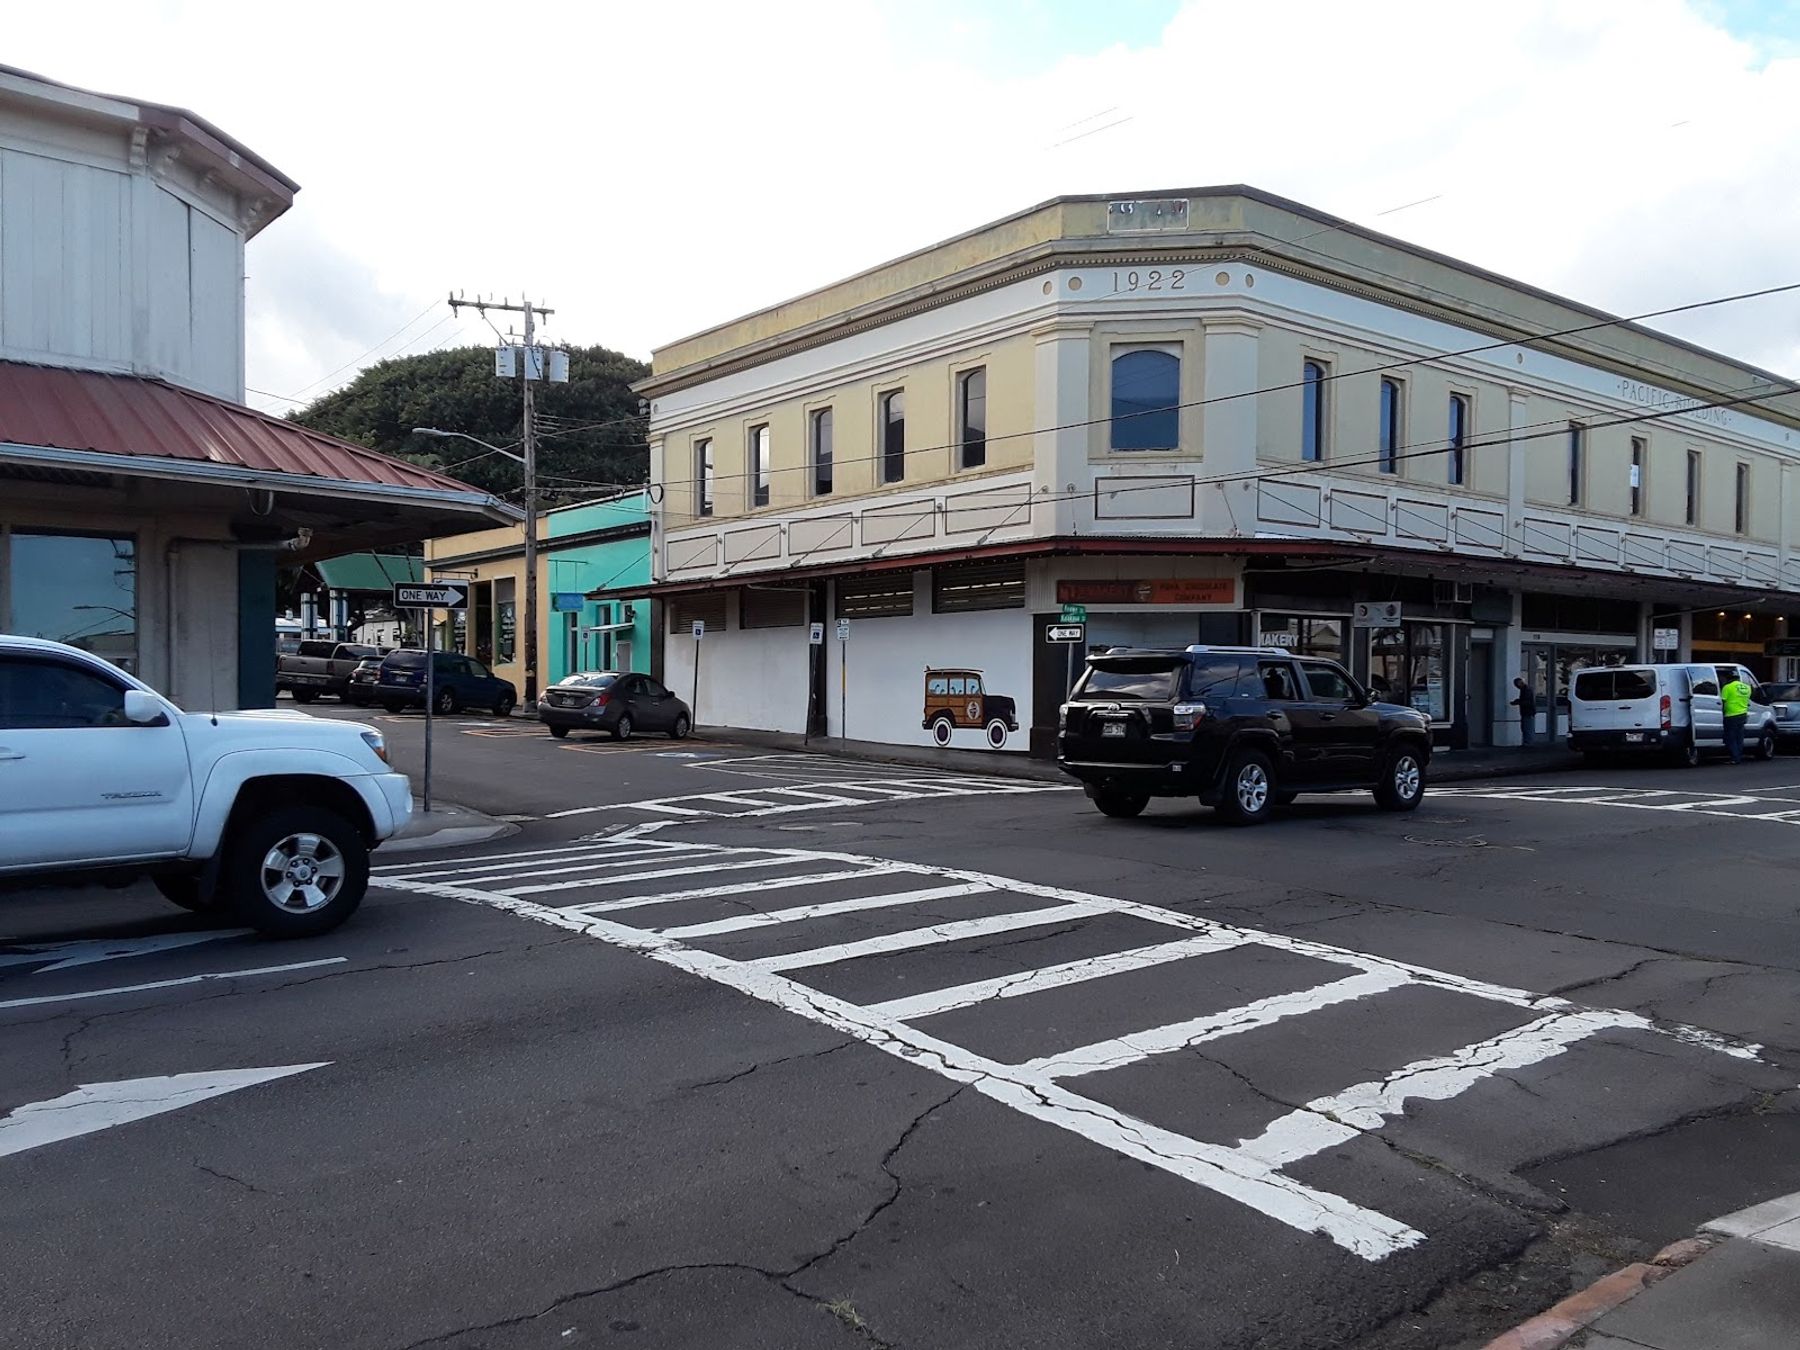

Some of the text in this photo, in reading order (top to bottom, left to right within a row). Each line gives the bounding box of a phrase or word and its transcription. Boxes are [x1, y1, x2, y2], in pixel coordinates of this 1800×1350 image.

[1113, 269, 1186, 293] 1922
[1622, 380, 1669, 409] PACIFIC
[402, 590, 447, 601] ONE WAY
